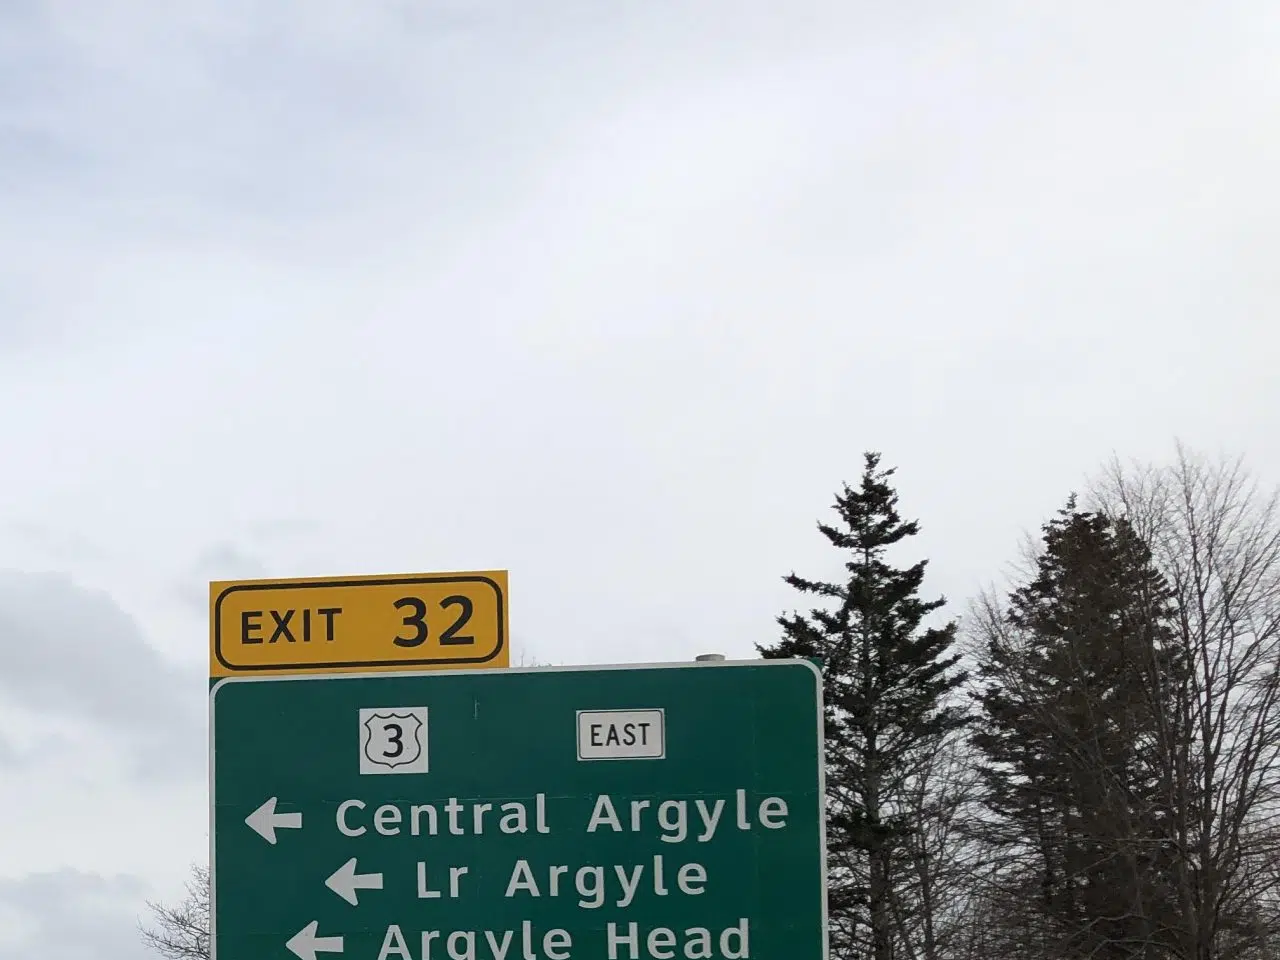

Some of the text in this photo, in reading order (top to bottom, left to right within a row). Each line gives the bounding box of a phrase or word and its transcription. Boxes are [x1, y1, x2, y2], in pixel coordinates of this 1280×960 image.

[241, 596, 475, 648] EXIT 32
[382, 723, 404, 758] 3
[590, 722, 651, 747] EAST
[336, 789, 789, 843] Central Argyle
[418, 855, 707, 909] Lr Argyle
[607, 918, 750, 960] Head
